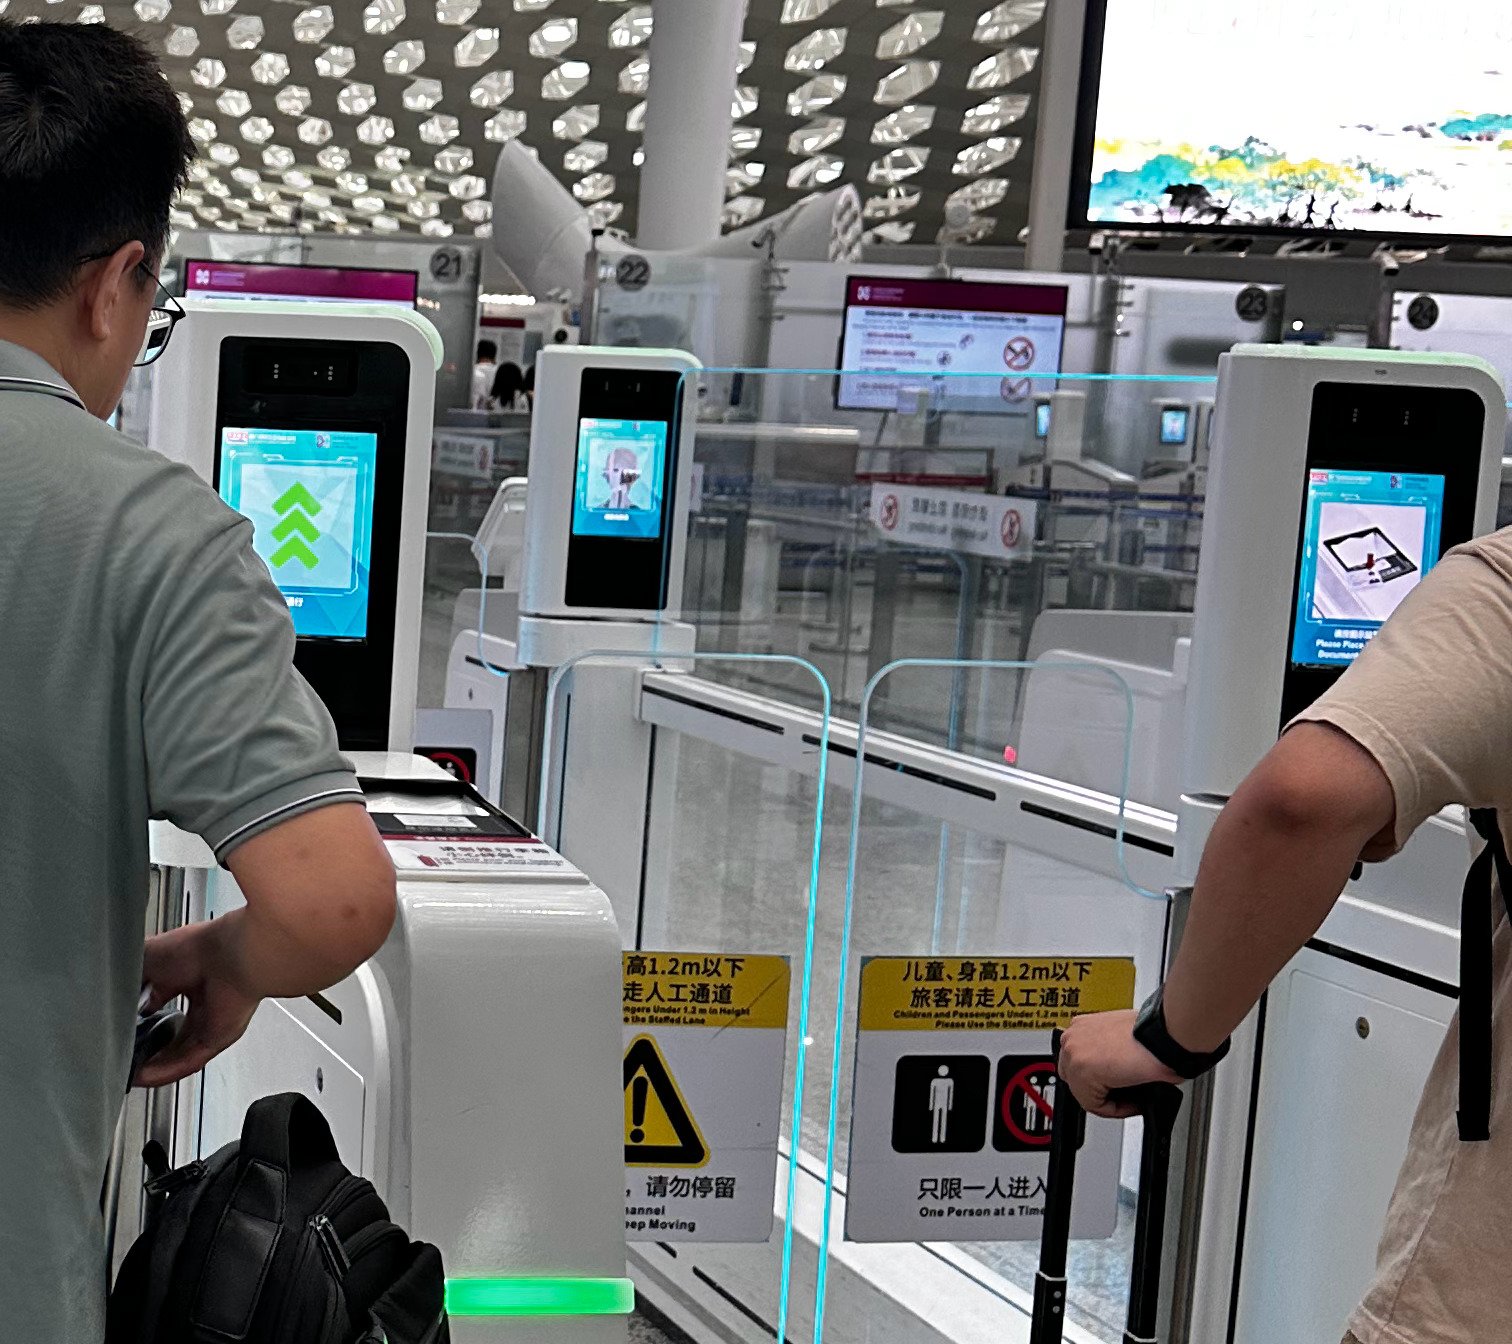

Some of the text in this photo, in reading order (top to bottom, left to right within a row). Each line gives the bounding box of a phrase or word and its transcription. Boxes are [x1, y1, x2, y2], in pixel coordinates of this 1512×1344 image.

[434, 254, 463, 278] 21
[618, 261, 648, 285] 22
[1241, 294, 1266, 316] 23
[625, 954, 745, 979] 高1.2m以下
[902, 959, 1093, 983] 儿童、身高1.2m以下
[622, 981, 734, 1004] 走人工通道
[909, 986, 1081, 1009] 旅客请走人工通道
[631, 1015, 647, 1024] the
[648, 1015, 682, 1025] Staffed
[682, 1016, 706, 1025] Lane
[653, 1005, 681, 1014] Under
[683, 1006, 697, 1014] 1.2
[709, 1007, 718, 1015] in
[719, 1007, 751, 1017] Height
[893, 1010, 933, 1019] Children
[934, 1010, 950, 1019] and
[951, 1010, 1006, 1020] Passengers
[1007, 1010, 1034, 1019] Under
[1035, 1010, 1049, 1019] 1.2
[935, 1020, 1057, 1029] Please Use the Staffed Lane
[917, 1176, 1048, 1201] 只限一人进入
[919, 1206, 945, 1218] One
[946, 1206, 991, 1217] Person
[993, 1206, 1006, 1217] at
[1008, 1208, 1016, 1217] a
[648, 1218, 696, 1233] Moving
